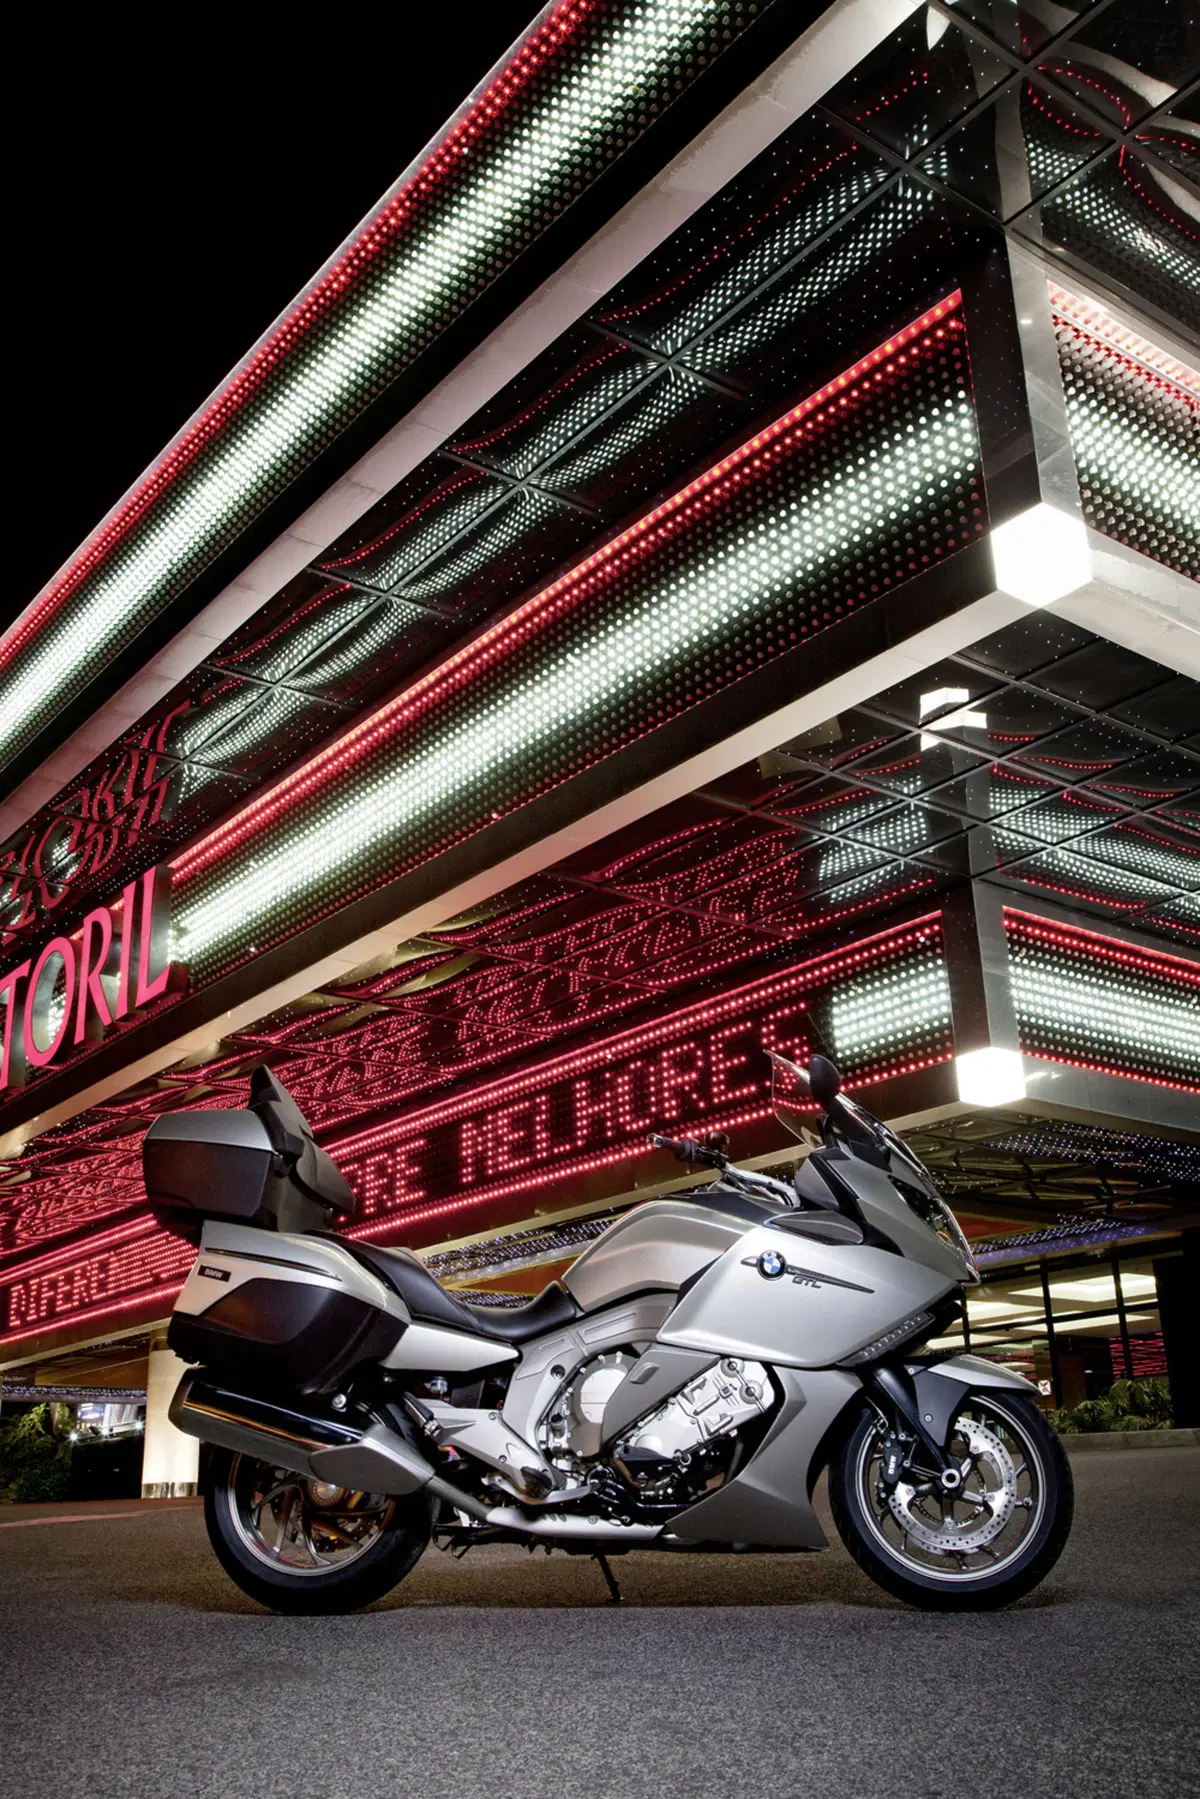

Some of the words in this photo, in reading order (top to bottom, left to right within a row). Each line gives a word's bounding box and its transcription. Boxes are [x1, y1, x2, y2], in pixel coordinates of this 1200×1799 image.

[0, 865, 171, 1091] TORIL
[461, 1002, 811, 1184] MELHORES
[204, 1267, 224, 1279] BMW
[791, 1275, 822, 1289] GTL
[887, 1455, 897, 1475] BMW
